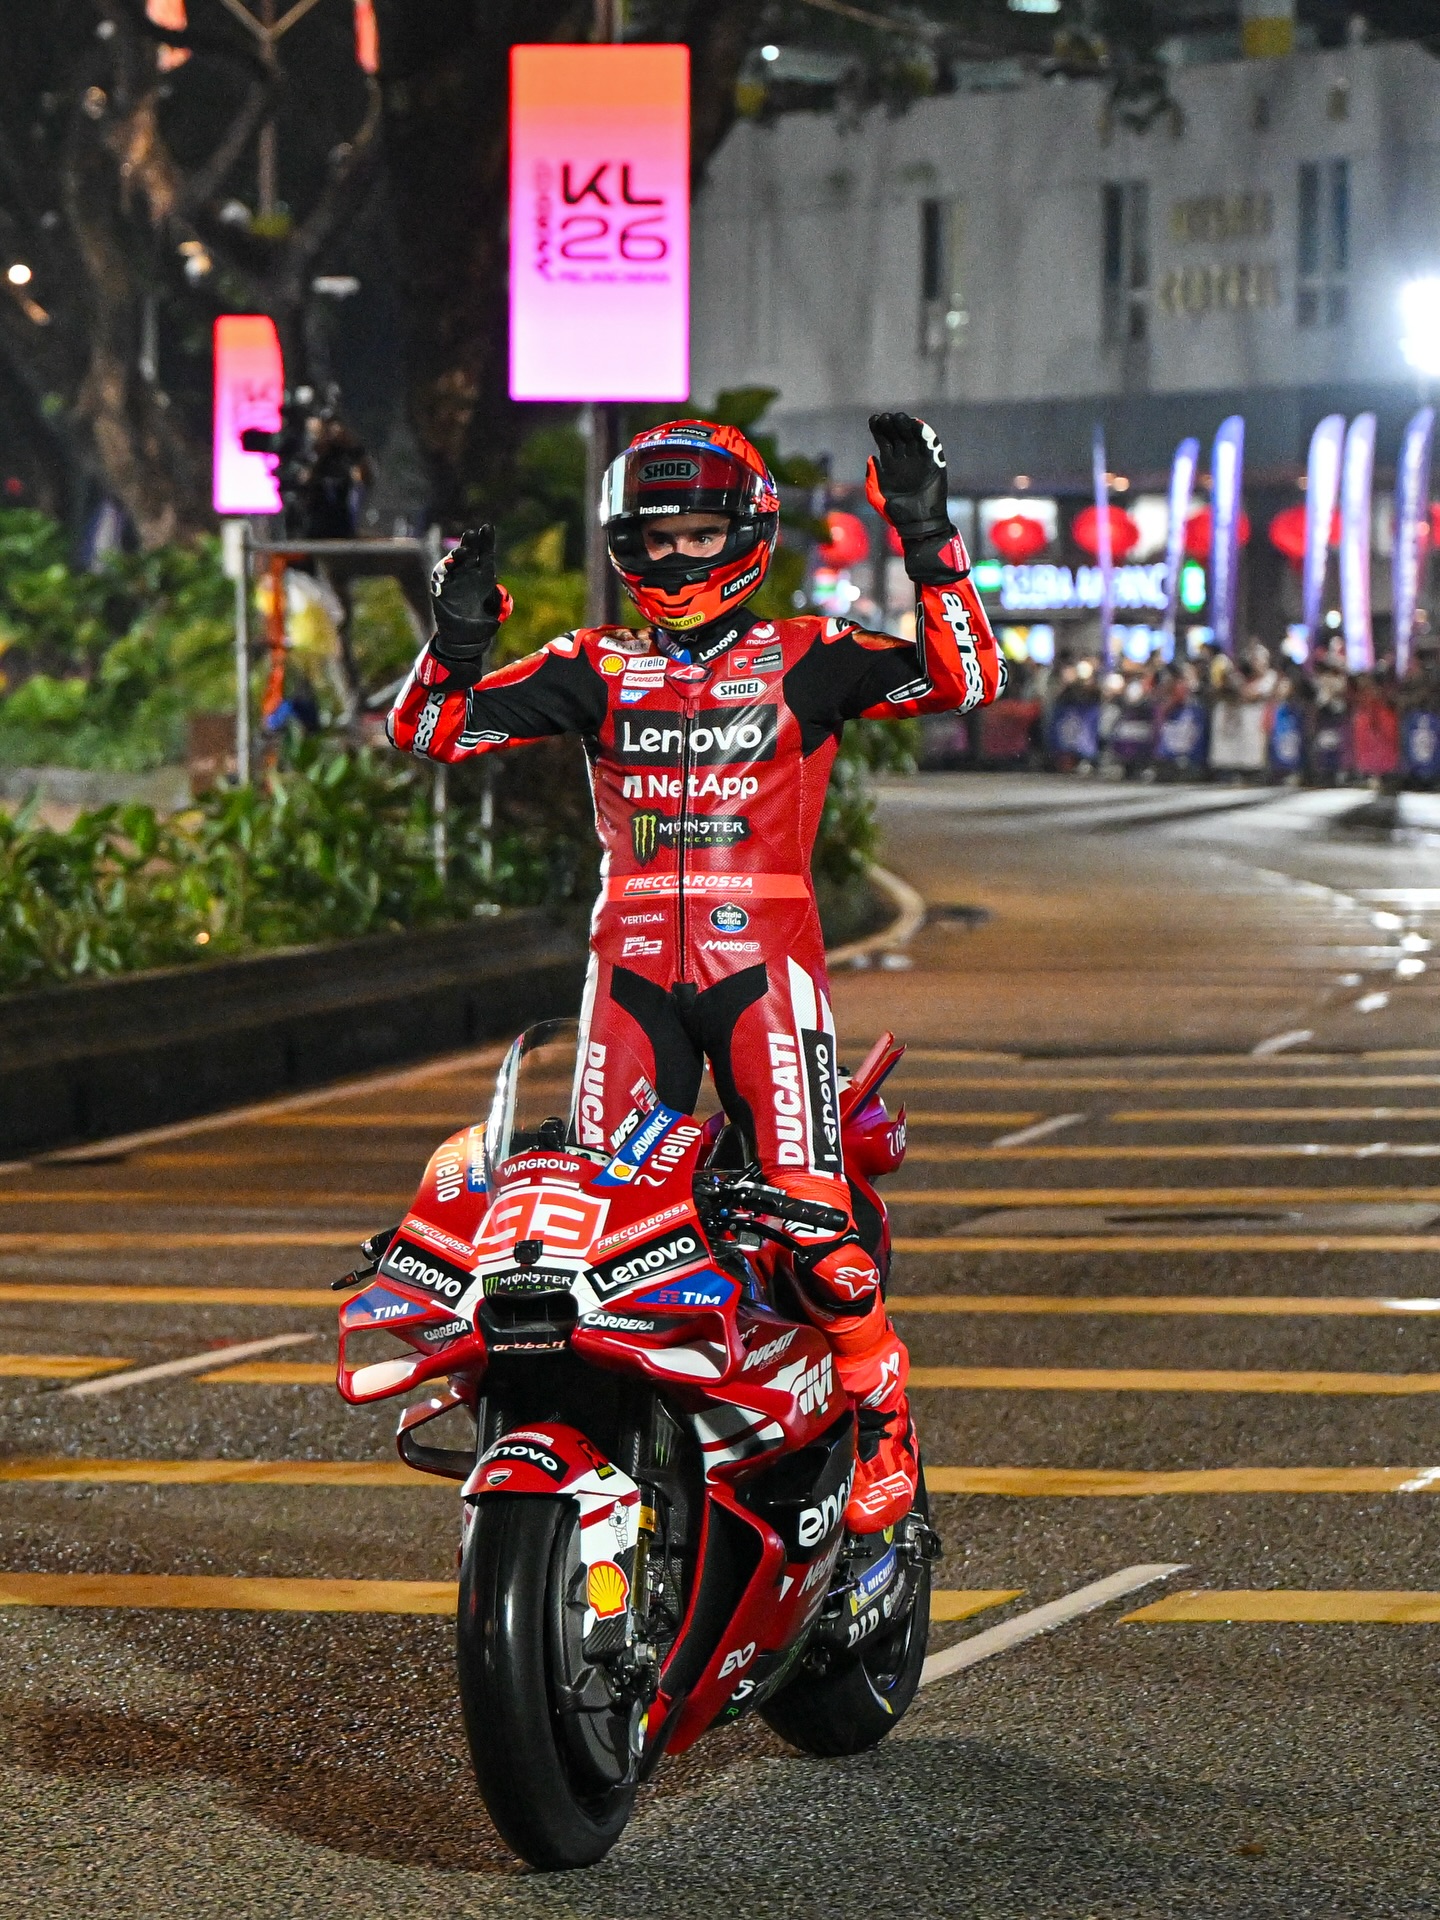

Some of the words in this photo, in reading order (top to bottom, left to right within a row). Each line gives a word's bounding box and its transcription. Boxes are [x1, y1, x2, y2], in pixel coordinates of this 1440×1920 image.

[562, 163, 664, 206] KL
[561, 215, 668, 262] 26
[667, 438, 692, 446] Galicia
[671, 427, 708, 437] Lenovo
[644, 462, 692, 480] SHOEI
[639, 504, 680, 516] Insta360
[723, 567, 760, 597] Lenovo
[666, 641, 685, 659] TIM
[699, 629, 738, 662] Lenovo
[941, 592, 985, 716] alpinesta
[639, 657, 665, 668] riello
[753, 654, 779, 664] Lenovo
[625, 675, 663, 683] CARRERA
[720, 682, 759, 696] SHOEI
[620, 691, 643, 702] SAP
[622, 721, 763, 753] Lenovo
[648, 773, 759, 800] NetApp
[620, 912, 665, 925] VERTICAL
[716, 910, 742, 919] Estrella
[717, 917, 742, 926] Galicia
[701, 939, 760, 952] MotoGP
[582, 1040, 607, 1151] DUCA
[767, 1032, 805, 1166] DUCATI
[815, 1043, 839, 1162] Lenovo
[631, 1111, 673, 1161] ADVANCE
[650, 1125, 702, 1173] riello
[435, 1151, 465, 1203] riello
[503, 1158, 581, 1178] VARGROUP
[476, 1191, 602, 1256] 93
[597, 1203, 689, 1250] FRECCIAROSSA
[407, 1219, 477, 1257] FRECCIAROSSA
[387, 1246, 463, 1298] Lenovo
[592, 1236, 696, 1292] Lenovo
[499, 1271, 573, 1287] MONSTER
[682, 1291, 722, 1305] TIM
[372, 1302, 410, 1320] TIM
[583, 1312, 655, 1331] CARRERA
[423, 1320, 469, 1342] CARRERA
[741, 1327, 800, 1372] DUCATI
